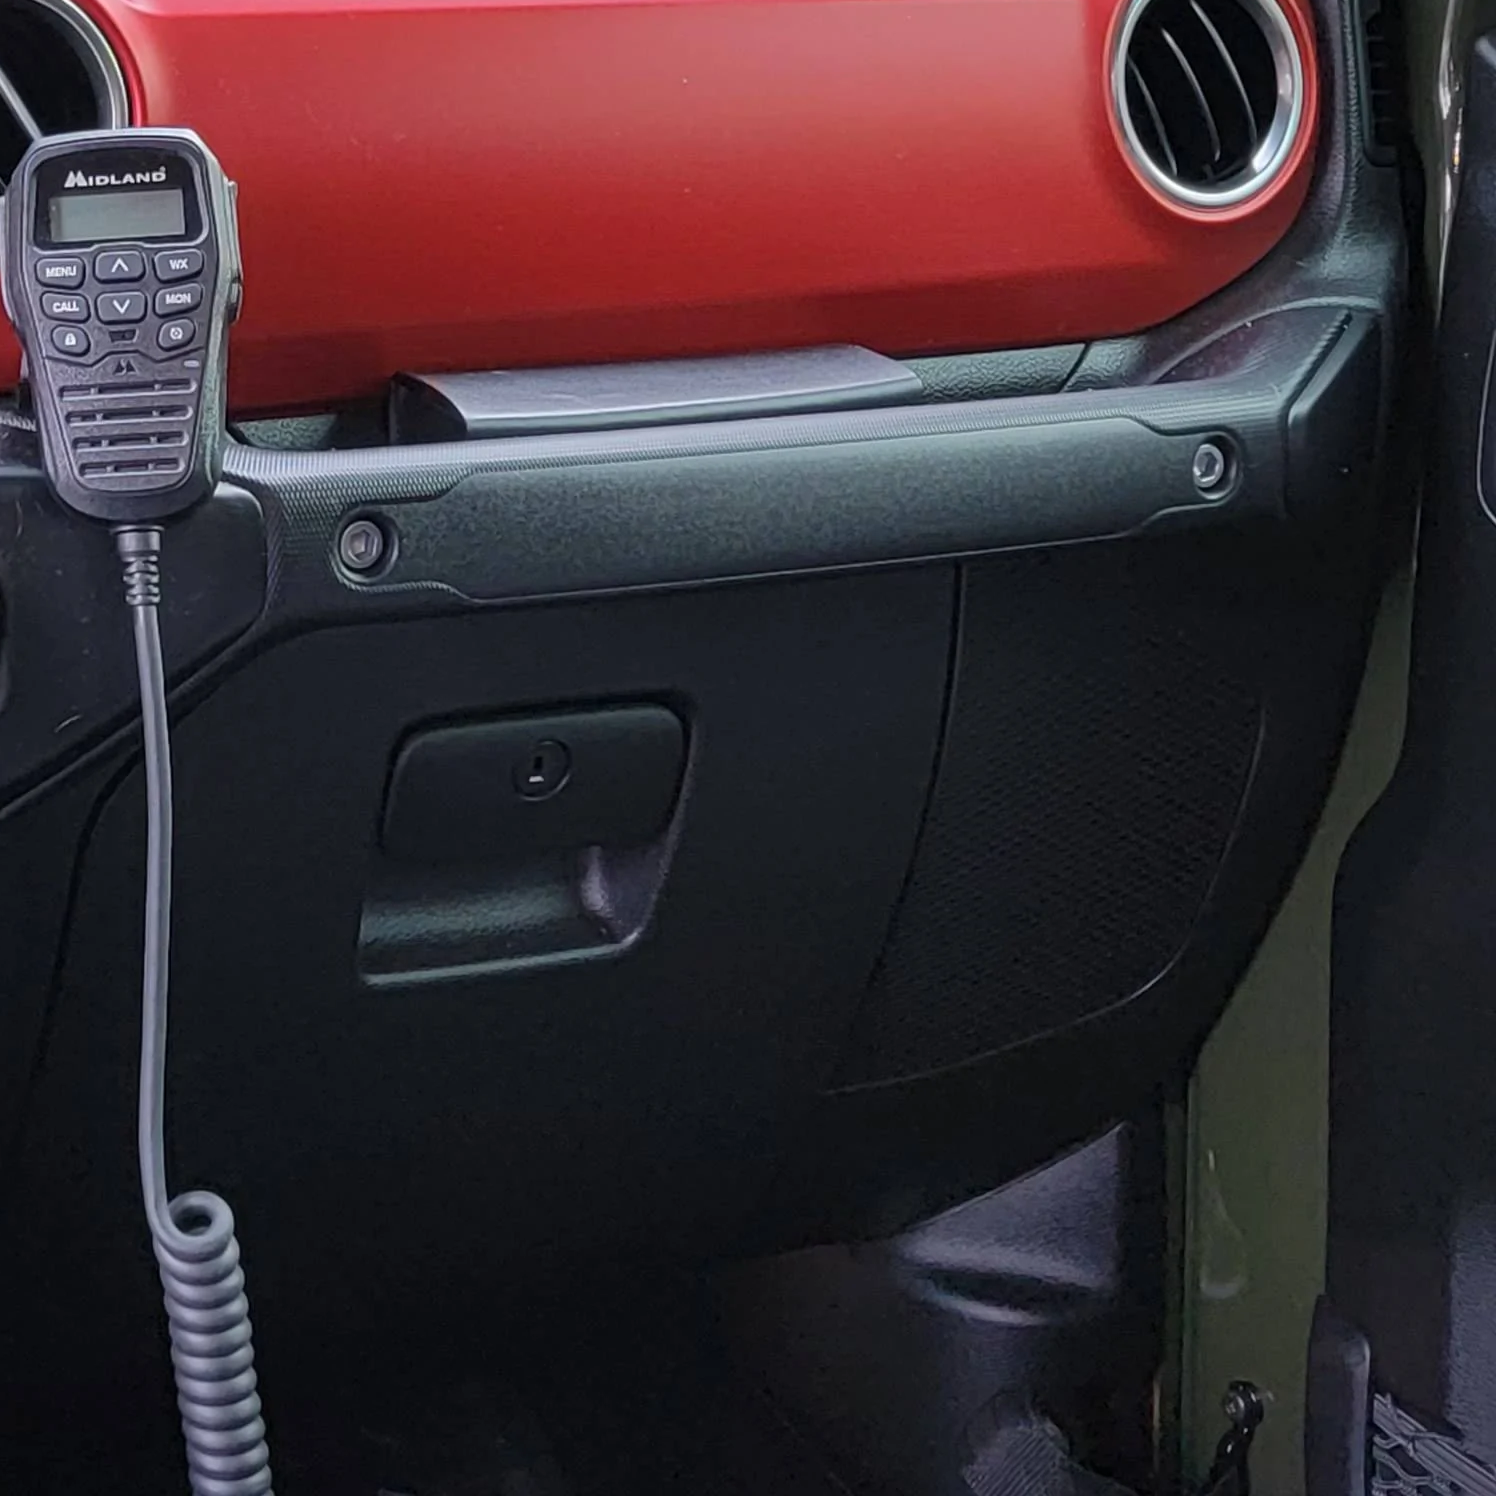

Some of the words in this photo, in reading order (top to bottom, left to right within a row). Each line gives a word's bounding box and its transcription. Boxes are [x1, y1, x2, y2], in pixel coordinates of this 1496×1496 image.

[63, 169, 167, 188] MIDLAND
[169, 257, 189, 270] WX
[45, 265, 77, 278] MENU
[165, 292, 192, 305] MON
[52, 300, 80, 313] CALL
